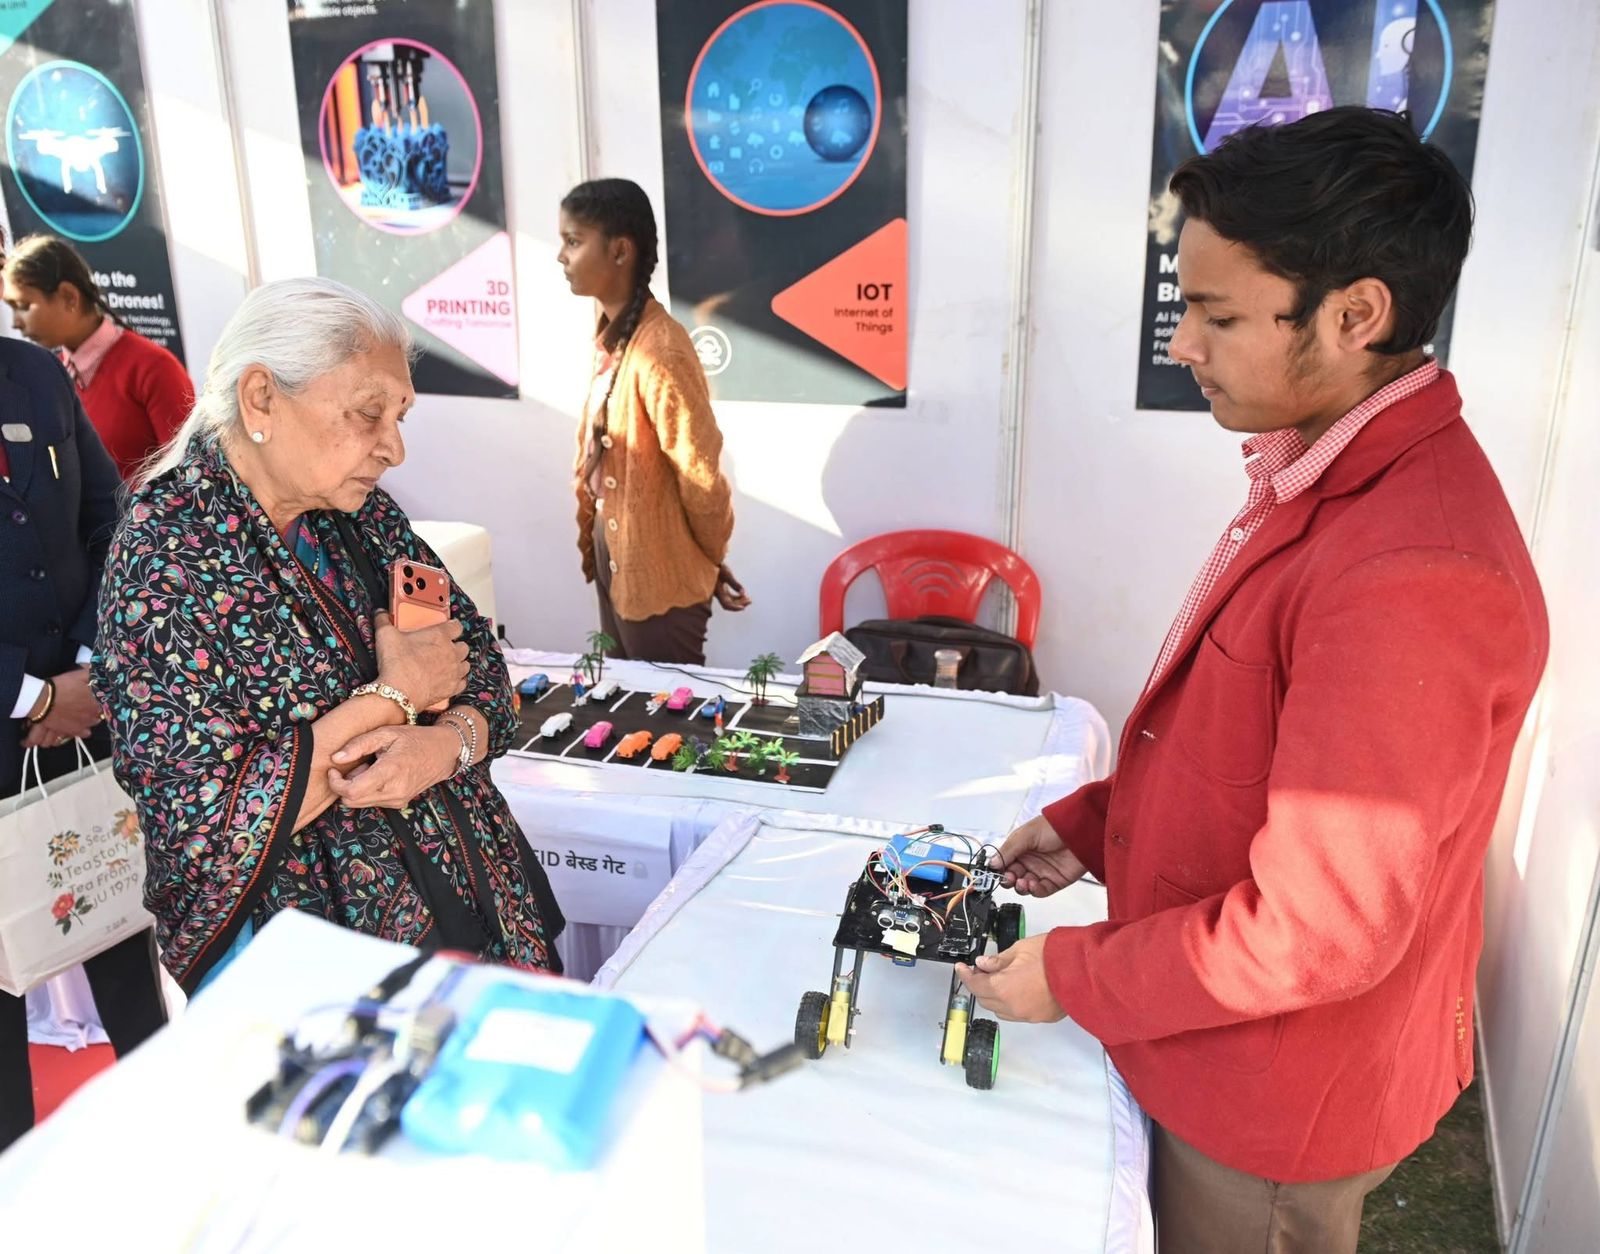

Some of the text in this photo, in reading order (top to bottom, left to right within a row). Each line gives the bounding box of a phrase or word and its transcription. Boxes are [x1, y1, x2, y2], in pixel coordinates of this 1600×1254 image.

[1203, 0, 1418, 153] AI
[92, 271, 137, 288] to the
[487, 280, 509, 296] 3D
[857, 283, 893, 301] IOT
[108, 292, 164, 310] Drones!
[427, 299, 511, 316] PRINTING
[834, 307, 893, 318] Internet of
[1155, 311, 1169, 323] AI
[856, 321, 893, 336] Things
[85, 832, 113, 846] Secr
[565, 850, 598, 872] बेस्ड
[602, 854, 626, 875] गेट
[96, 862, 132, 887] From
[110, 872, 139, 897] 1979
